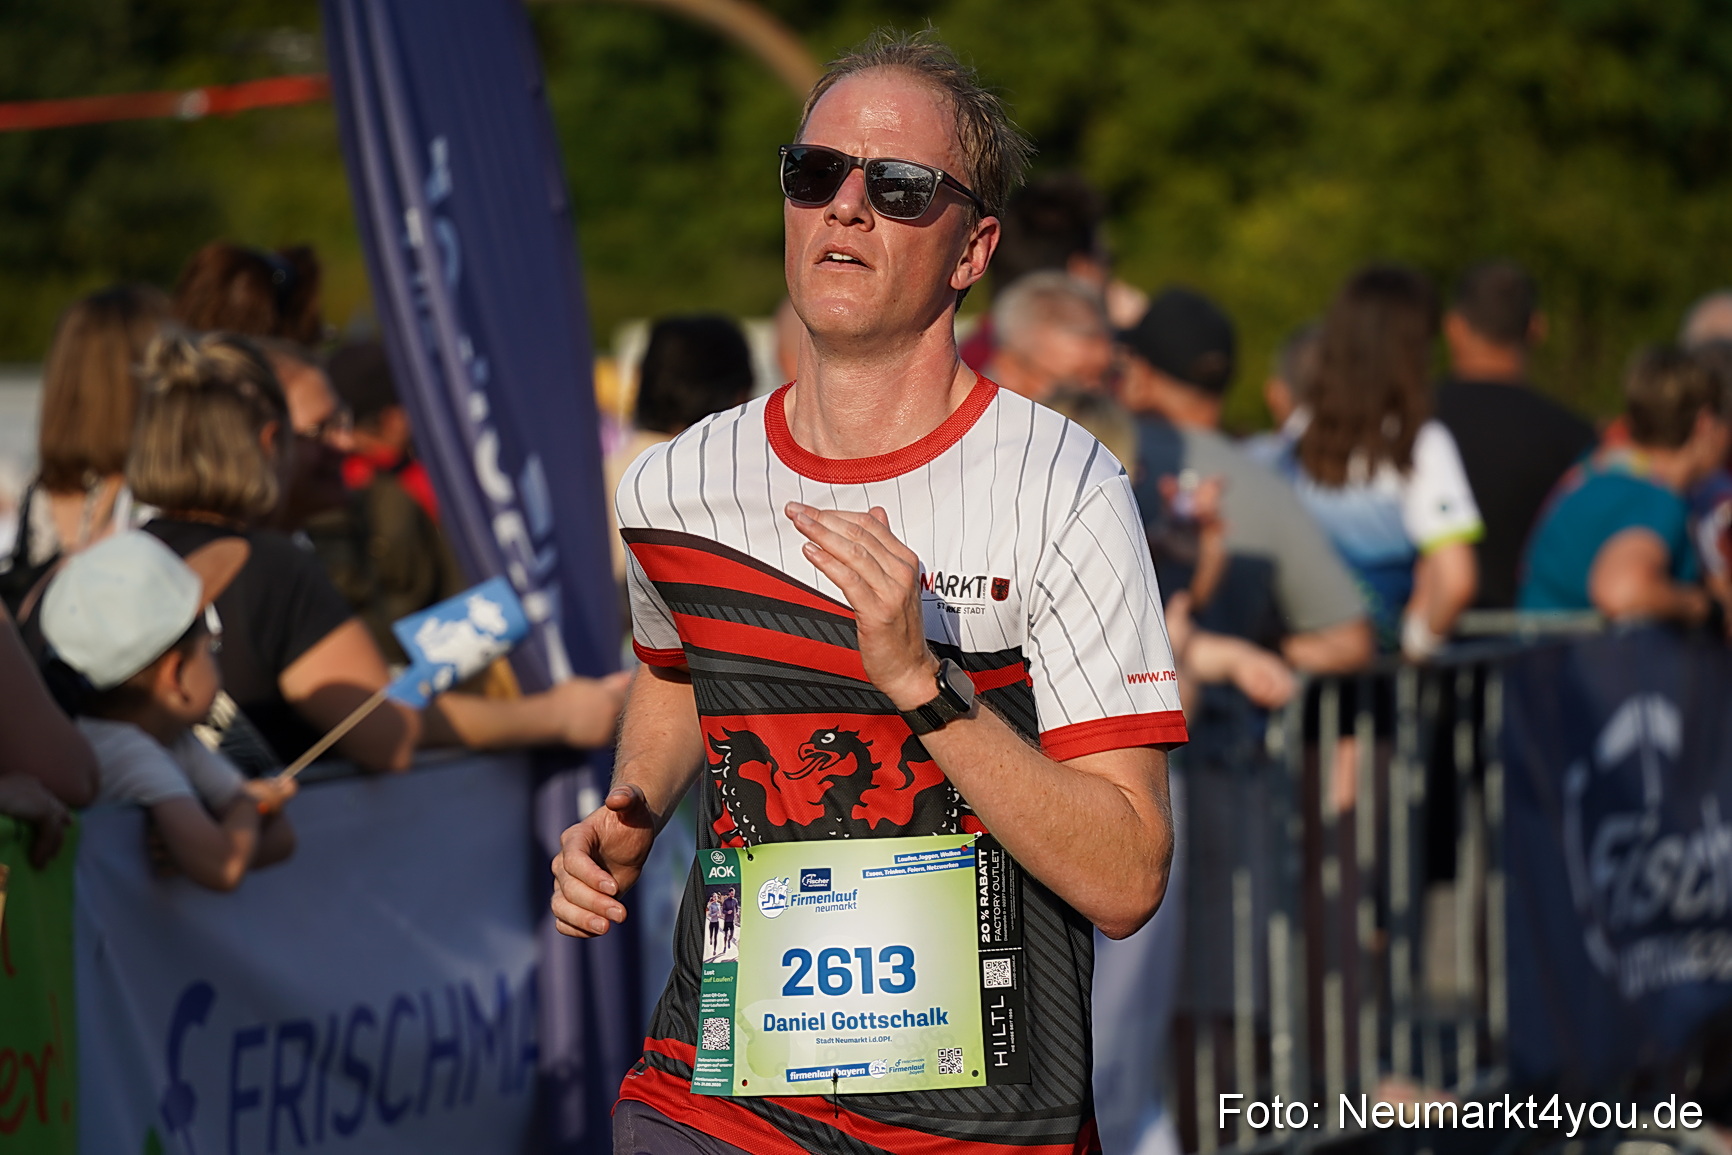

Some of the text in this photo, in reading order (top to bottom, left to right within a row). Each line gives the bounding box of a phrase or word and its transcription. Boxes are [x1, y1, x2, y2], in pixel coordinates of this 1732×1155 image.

[937, 602, 985, 615] STRKE STADT
[940, 850, 961, 858] Walken
[708, 866, 736, 878] AOK
[926, 862, 959, 871] Netzwerken
[790, 889, 858, 907] Firmenlauf
[978, 849, 991, 943] 20 % RABATT
[992, 849, 1002, 942] FACTORY OUTLET
[815, 901, 857, 913] neumarkt
[781, 945, 916, 996] 2613
[763, 1006, 949, 1032] Daniel Gottschalk
[990, 995, 1008, 1067] HILTL
[835, 1036, 867, 1044] Neumarkt
[889, 1063, 925, 1073] Firmenlauf
